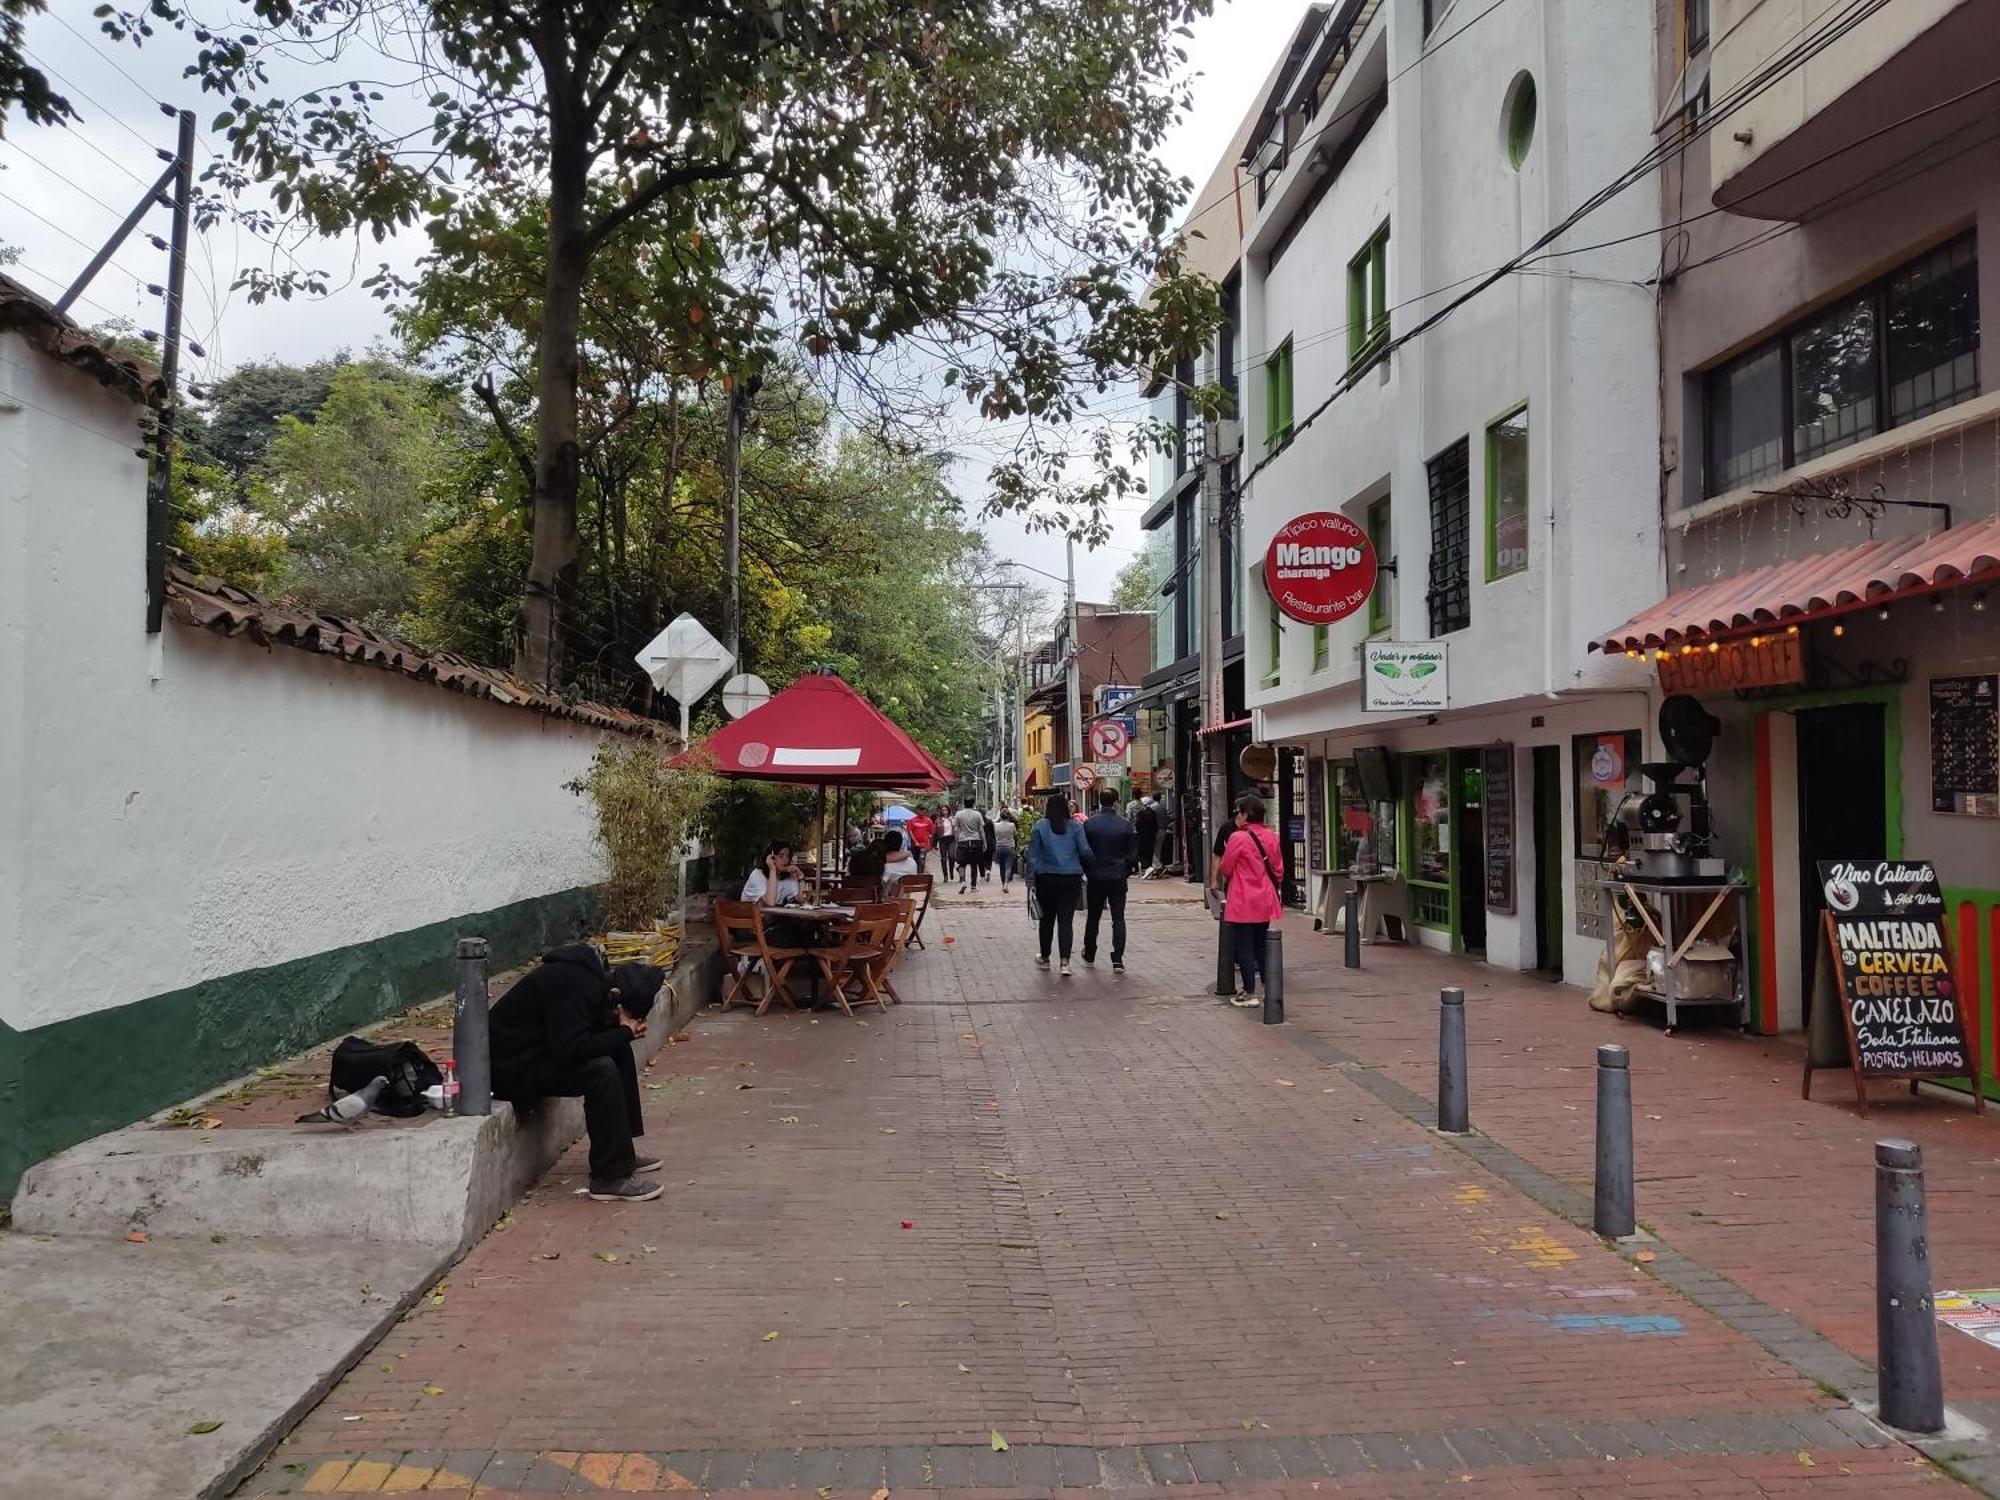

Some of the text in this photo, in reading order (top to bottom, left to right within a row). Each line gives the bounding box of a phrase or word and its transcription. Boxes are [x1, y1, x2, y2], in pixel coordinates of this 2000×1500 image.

[1320, 517, 1359, 538] valluno
[1276, 543, 1361, 570] Mango
[1277, 568, 1330, 580] charanga
[1282, 589, 1364, 615] Restaurante bar
[1830, 862, 1935, 885] Vino Caliente
[1894, 893, 1941, 905] Hot Wine
[1838, 921, 1942, 950] MALTEADA
[1844, 951, 1948, 974] DE CERVEZA
[1855, 975, 1937, 997] COFFEE
[1851, 997, 1954, 1026] CANELAZO
[1857, 1025, 1960, 1049] Soda Italiana
[1863, 1049, 1963, 1069] POSTRES HELADOS
